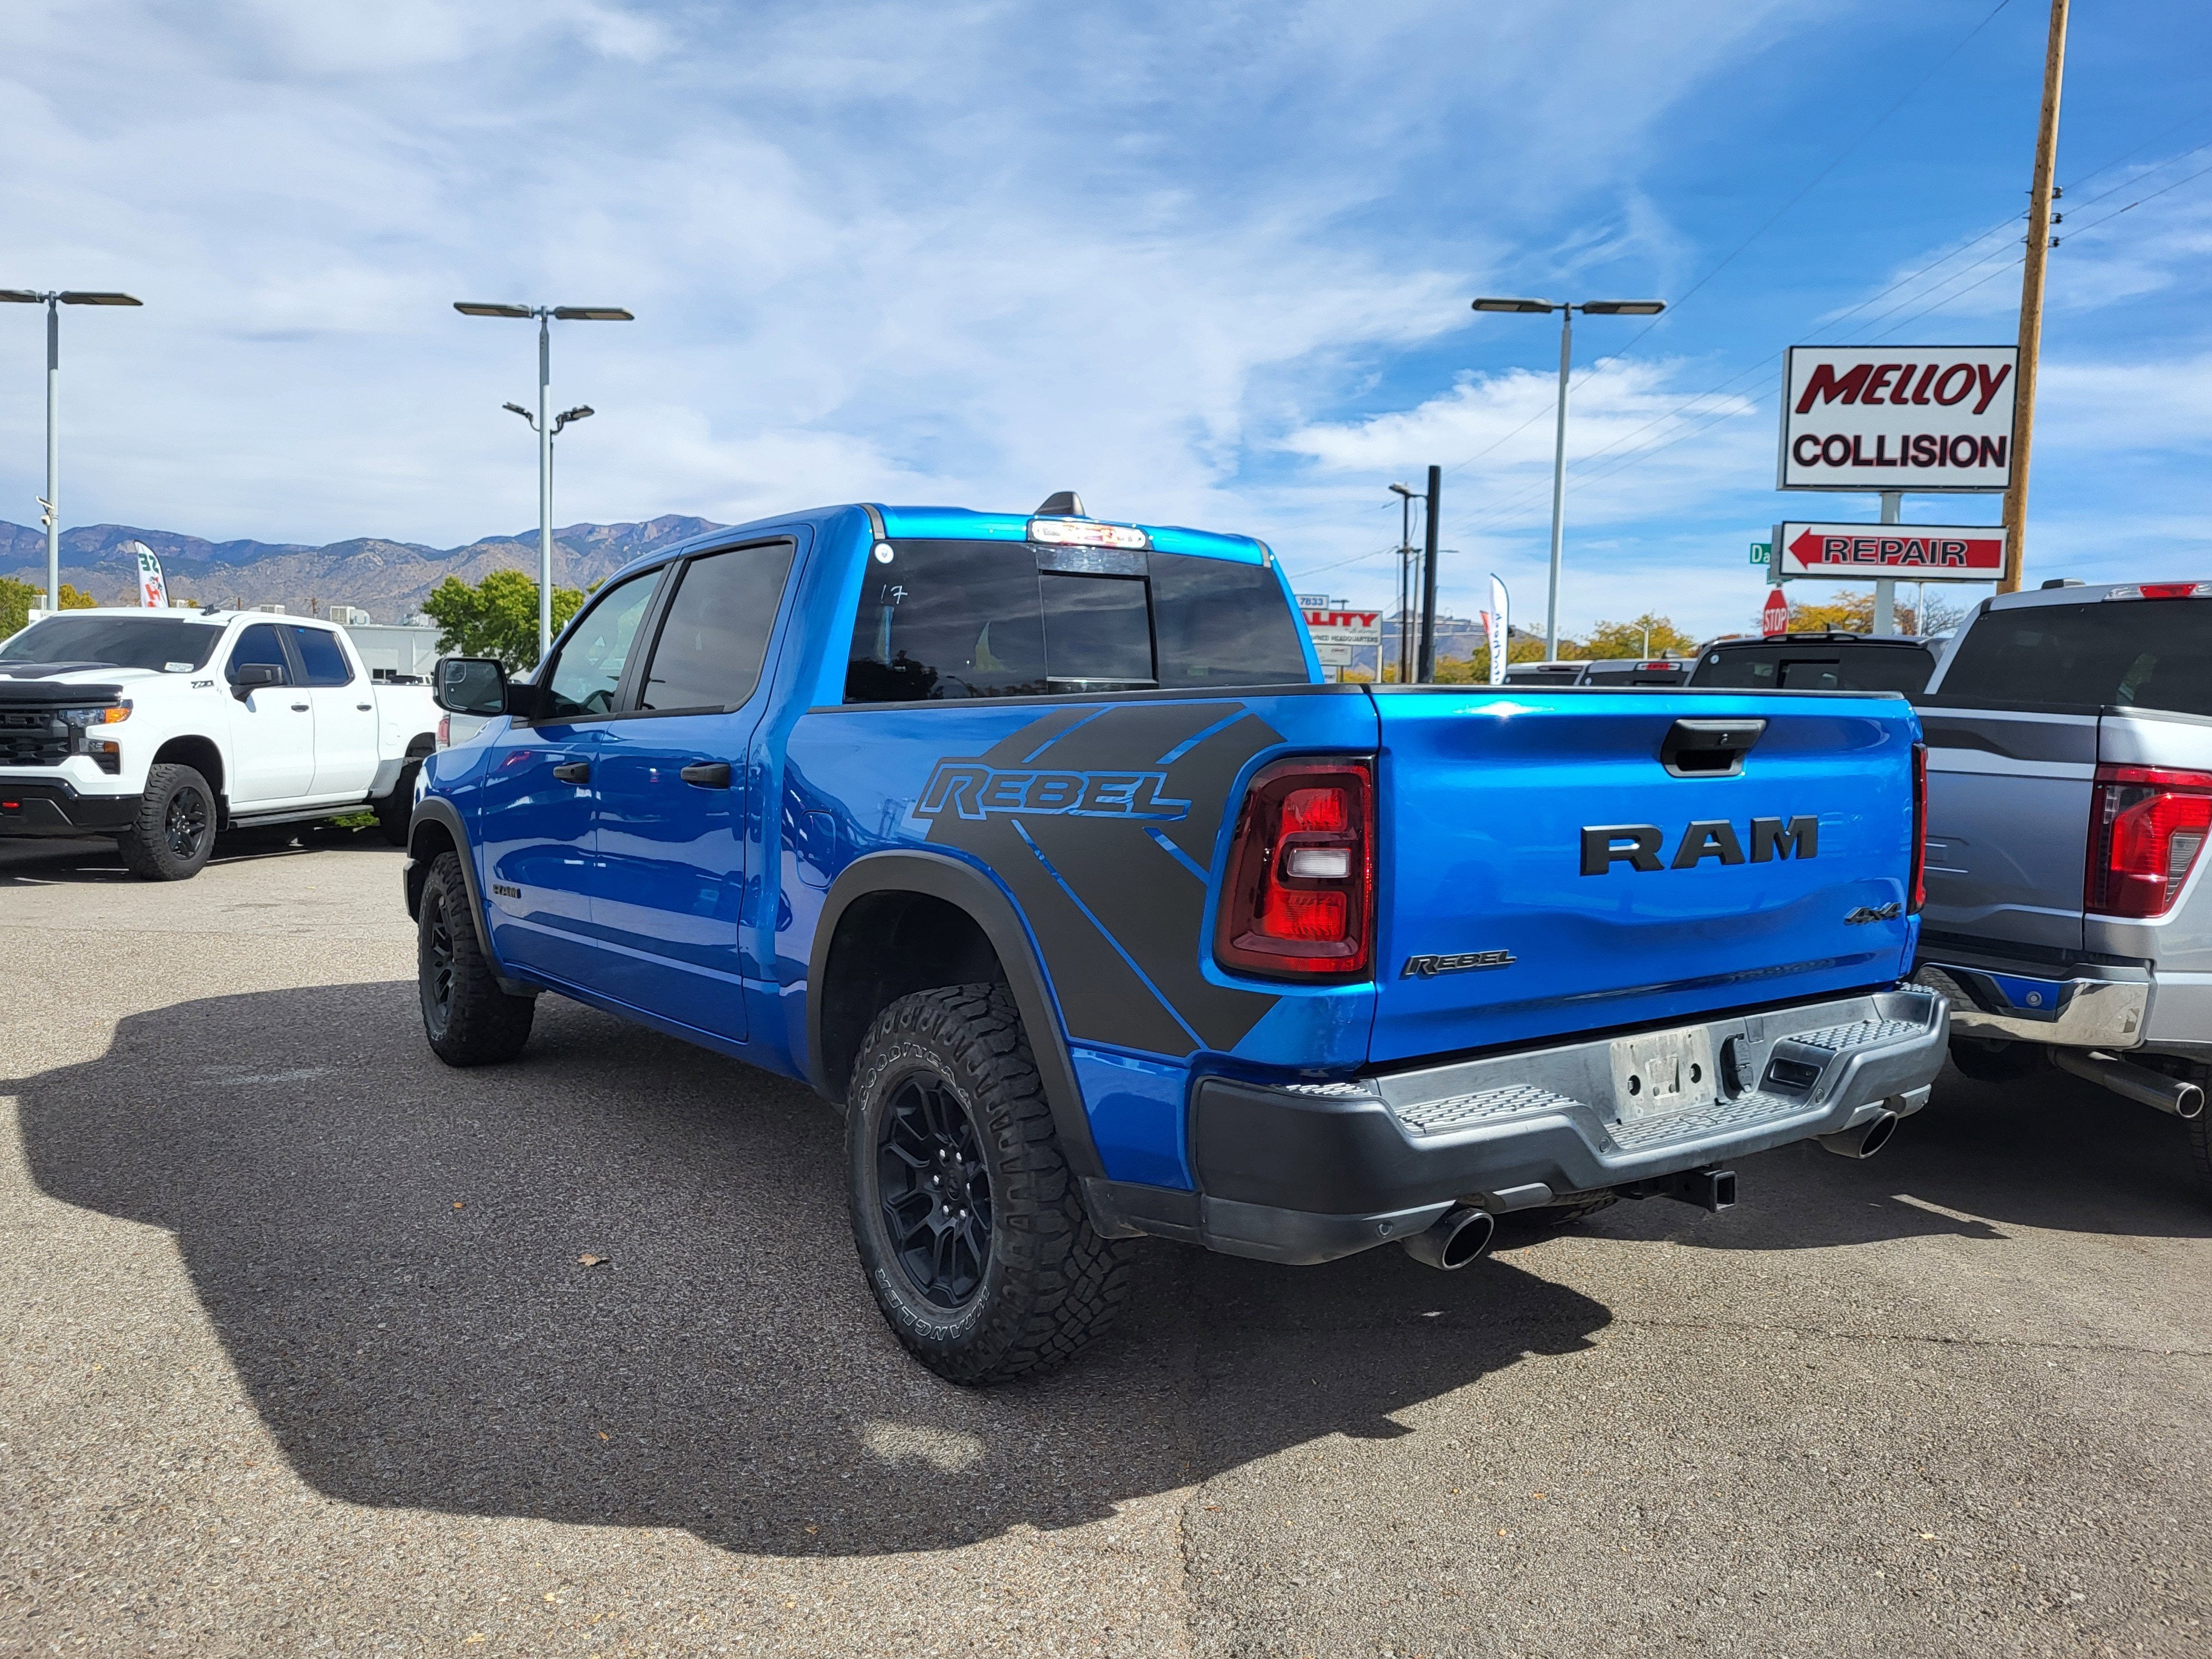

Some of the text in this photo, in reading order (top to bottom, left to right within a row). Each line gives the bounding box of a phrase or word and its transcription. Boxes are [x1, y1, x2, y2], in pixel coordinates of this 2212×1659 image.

[1795, 363, 2012, 414] MELLOY
[1793, 433, 2008, 468] COLLISION
[1822, 537, 1968, 567] REPAIR
[880, 584, 908, 604] 17
[1764, 608, 1787, 632] STOP
[919, 763, 1192, 821] REBEL
[1580, 815, 1818, 876] RAM
[493, 884, 521, 899] RAM
[1405, 948, 1518, 976] REBEL
[875, 1267, 990, 1341] WRANGLER
